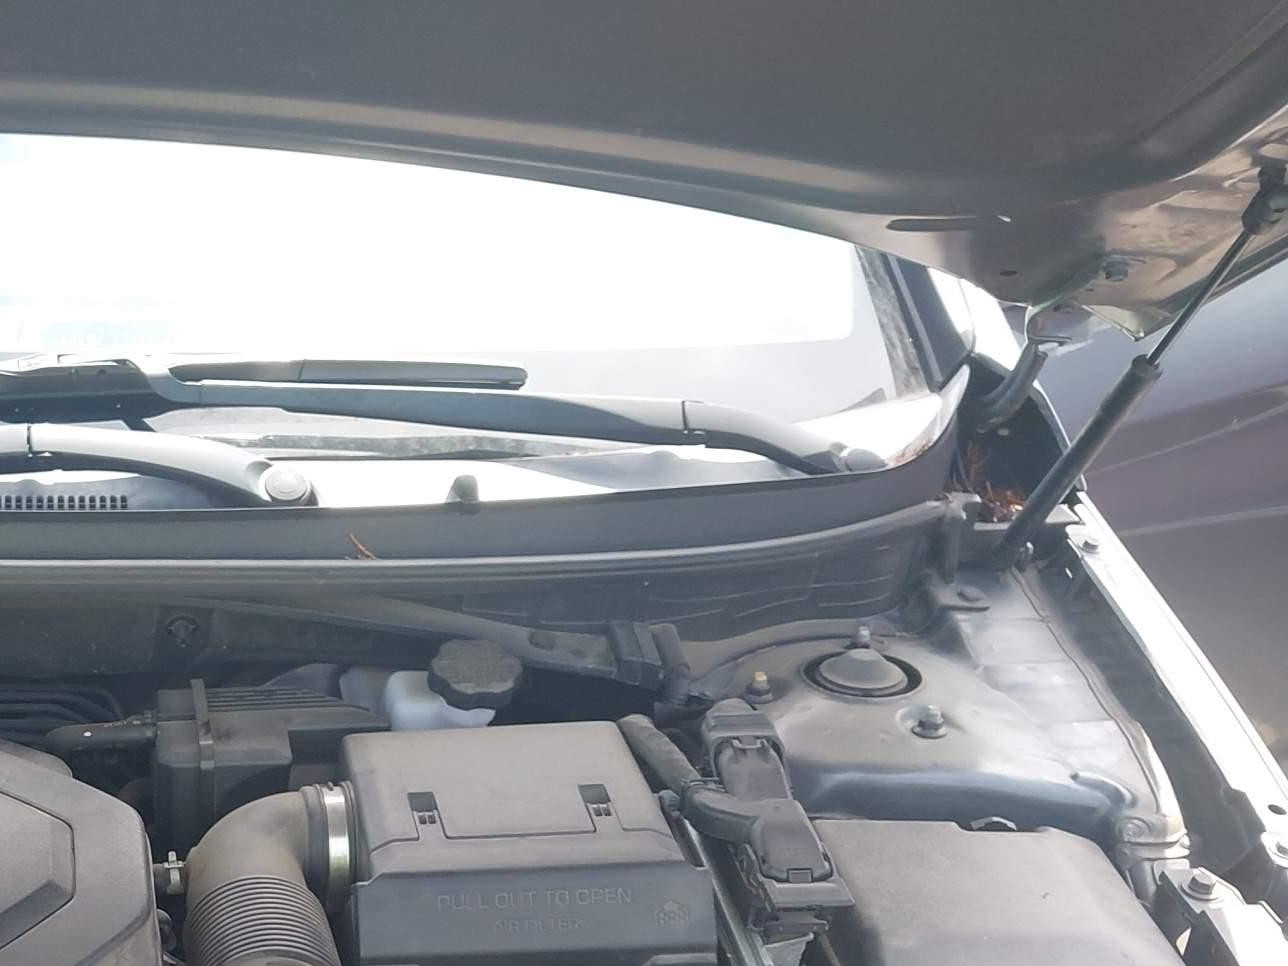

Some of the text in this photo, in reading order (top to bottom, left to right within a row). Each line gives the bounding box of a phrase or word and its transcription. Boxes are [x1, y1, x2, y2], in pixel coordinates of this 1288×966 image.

[438, 887, 632, 911] PULL OUT TO OPEN
[494, 917, 582, 932] AIR FILTER
